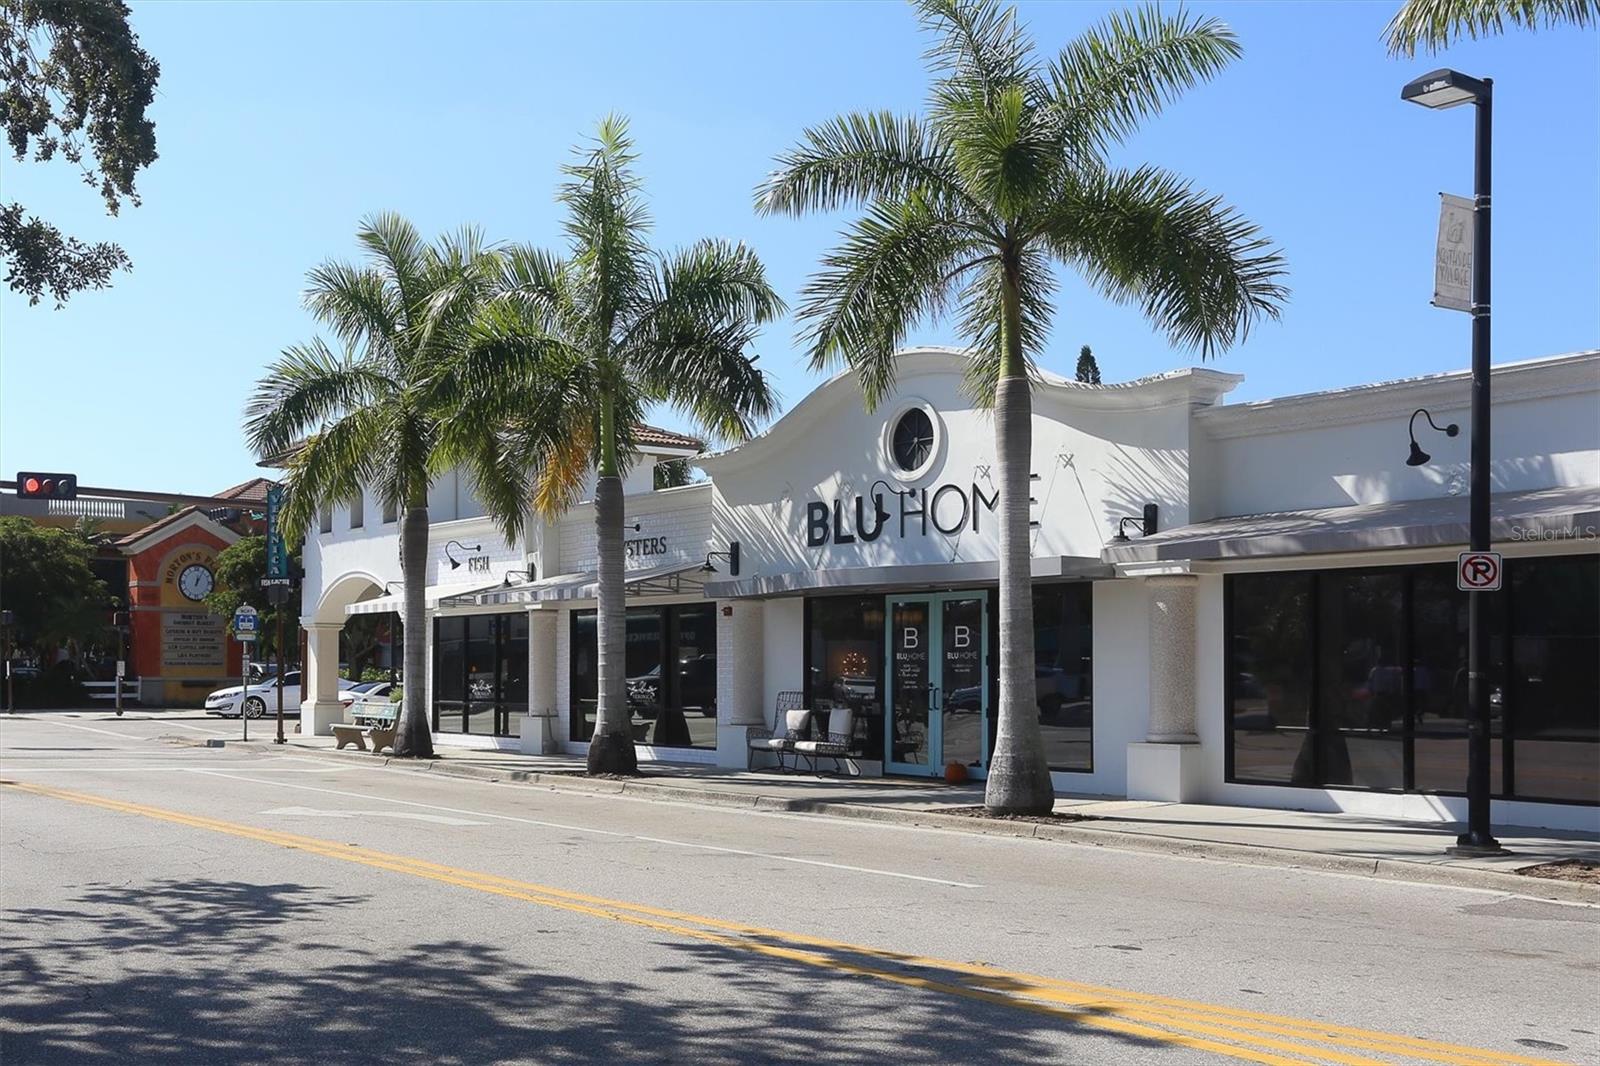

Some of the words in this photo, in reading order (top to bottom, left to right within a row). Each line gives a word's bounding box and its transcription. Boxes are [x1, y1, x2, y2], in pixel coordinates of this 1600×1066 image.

[807, 493, 884, 548] BLU
[623, 536, 667, 557] STERS
[468, 556, 489, 572] FISH
[903, 627, 919, 648] B
[955, 625, 970, 648] B
[896, 652, 908, 660] BLU
[947, 651, 960, 660] BLU
